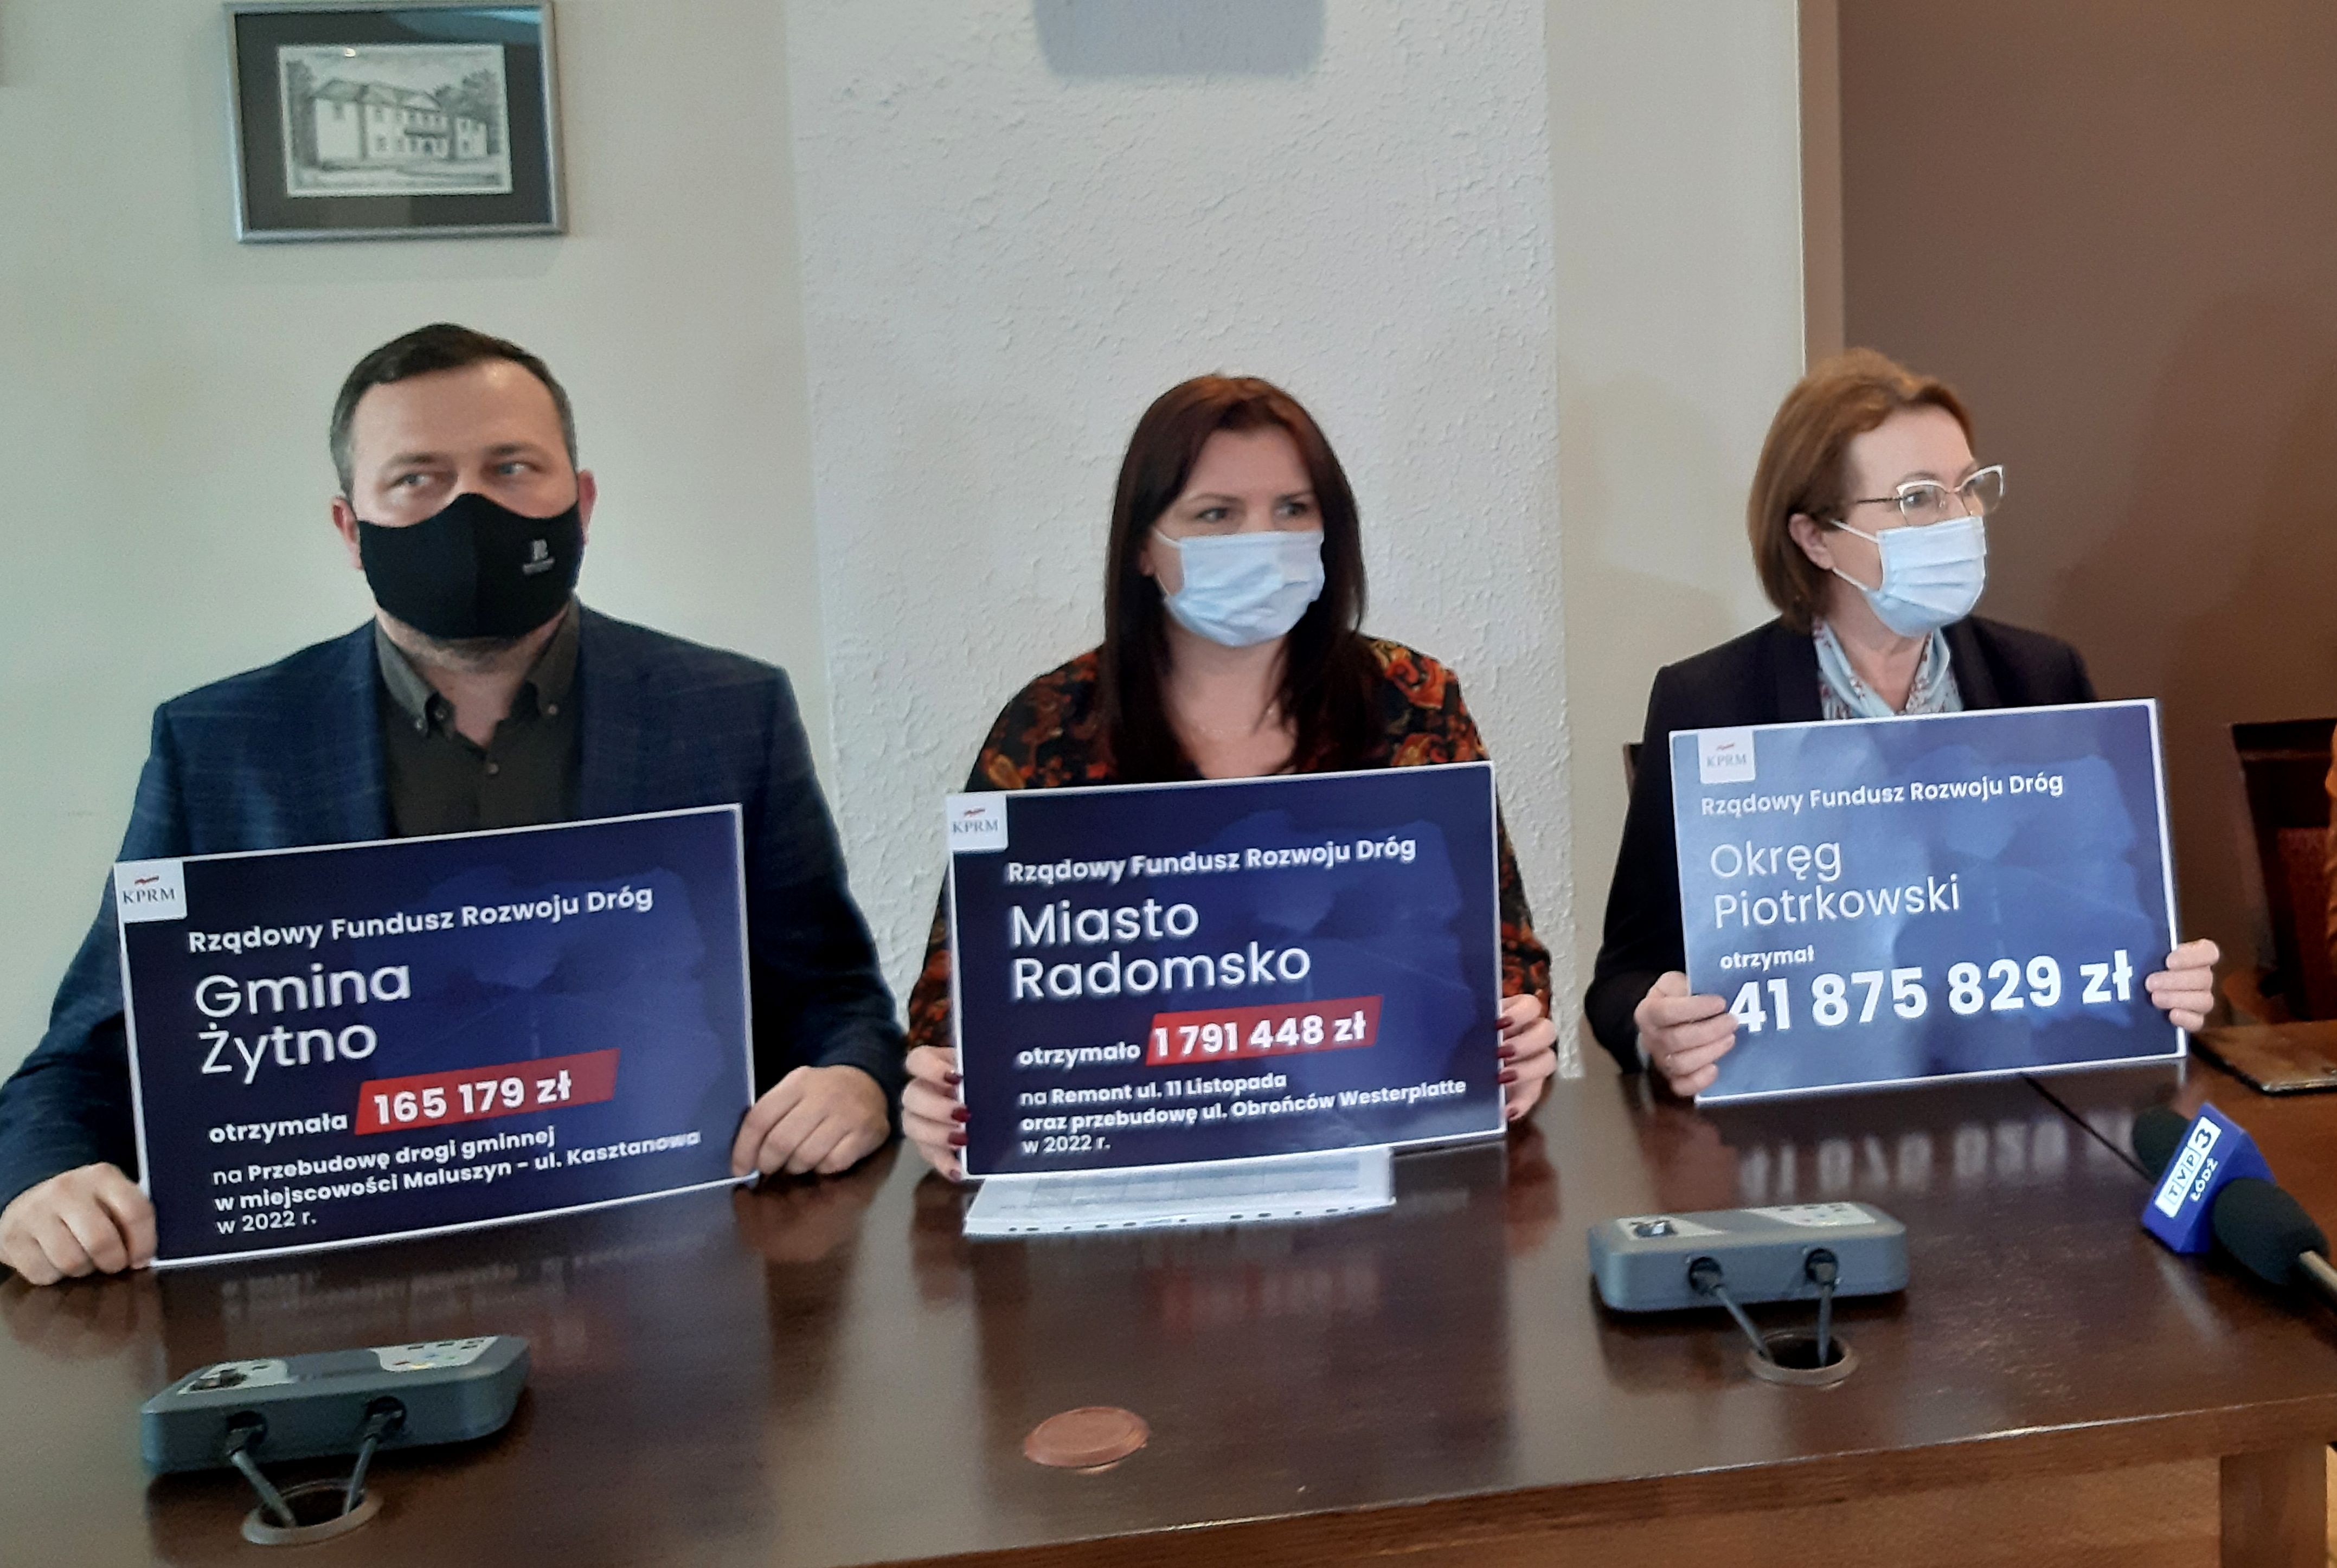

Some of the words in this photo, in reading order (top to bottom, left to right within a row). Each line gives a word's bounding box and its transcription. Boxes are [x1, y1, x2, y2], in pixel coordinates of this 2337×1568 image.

[1706, 753, 1748, 768] KPRM
[1702, 793, 1803, 817] Rządowy
[1809, 786, 1905, 808] Fundusz
[1910, 776, 2003, 801] Rozwoju
[2009, 772, 2064, 797] Dróg
[952, 820, 999, 834] KPRM
[1009, 859, 1126, 884] Rządowy
[1131, 851, 1240, 875] Fundusz
[1246, 840, 1350, 869] Rozwoju
[1357, 836, 1417, 861] Dróg
[1710, 840, 1842, 882] Okręg
[122, 887, 176, 905] KPRM
[188, 925, 323, 955] Rządowy
[331, 911, 458, 941] Fundusz
[462, 894, 579, 926] Rozwoju
[586, 885, 654, 912] Dróg
[1715, 873, 1960, 928] Piotrkowski
[1011, 898, 1199, 946] Miasto
[1013, 941, 1311, 998] Radomsko
[1720, 945, 1814, 972] otrzymał
[195, 963, 412, 1018] Gmina
[1728, 978, 1792, 1033] 41
[1811, 967, 1929, 1026] 875
[1948, 955, 2062, 1016] 829
[2080, 949, 2133, 1003] zł
[198, 1022, 377, 1084] Żytno
[1019, 1042, 1141, 1070] otrzymało
[1154, 1027, 1168, 1057] 1
[1178, 1021, 1238, 1055] 791
[1249, 1015, 1324, 1049] 448
[1334, 1011, 1366, 1042] zł
[208, 1113, 348, 1145] otrzymała
[373, 1087, 447, 1124] 165
[458, 1077, 524, 1114] 179
[536, 1070, 573, 1104] zł
[1020, 1091, 1047, 1106] na
[1051, 1084, 1133, 1104] Remont
[1137, 1082, 1163, 1100] ul.
[1166, 1080, 1182, 1098] 11
[1186, 1072, 1287, 1096] Listopada
[1022, 1118, 1067, 1132] oraz
[1071, 1108, 1197, 1134] przebudowę
[1201, 1102, 1228, 1120] ul.
[1231, 1093, 1334, 1117] Obrońców
[1339, 1079, 1466, 1107] Westerplatte
[213, 1167, 242, 1185] na
[248, 1152, 390, 1183] Przebudowę
[395, 1139, 457, 1164] drogi
[461, 1126, 556, 1159] gminnej
[1023, 1138, 1039, 1154] w
[1043, 1135, 1093, 1153] 2022
[1097, 1136, 1110, 1151] r.
[214, 1196, 235, 1212] w
[240, 1175, 398, 1209] miejscowości
[403, 1160, 512, 1189] Maluszyn
[534, 1150, 563, 1170] ul.
[567, 1130, 701, 1165] Kasztanowa
[217, 1219, 236, 1235] w
[242, 1211, 294, 1232] 2022
[302, 1211, 317, 1225] r.
